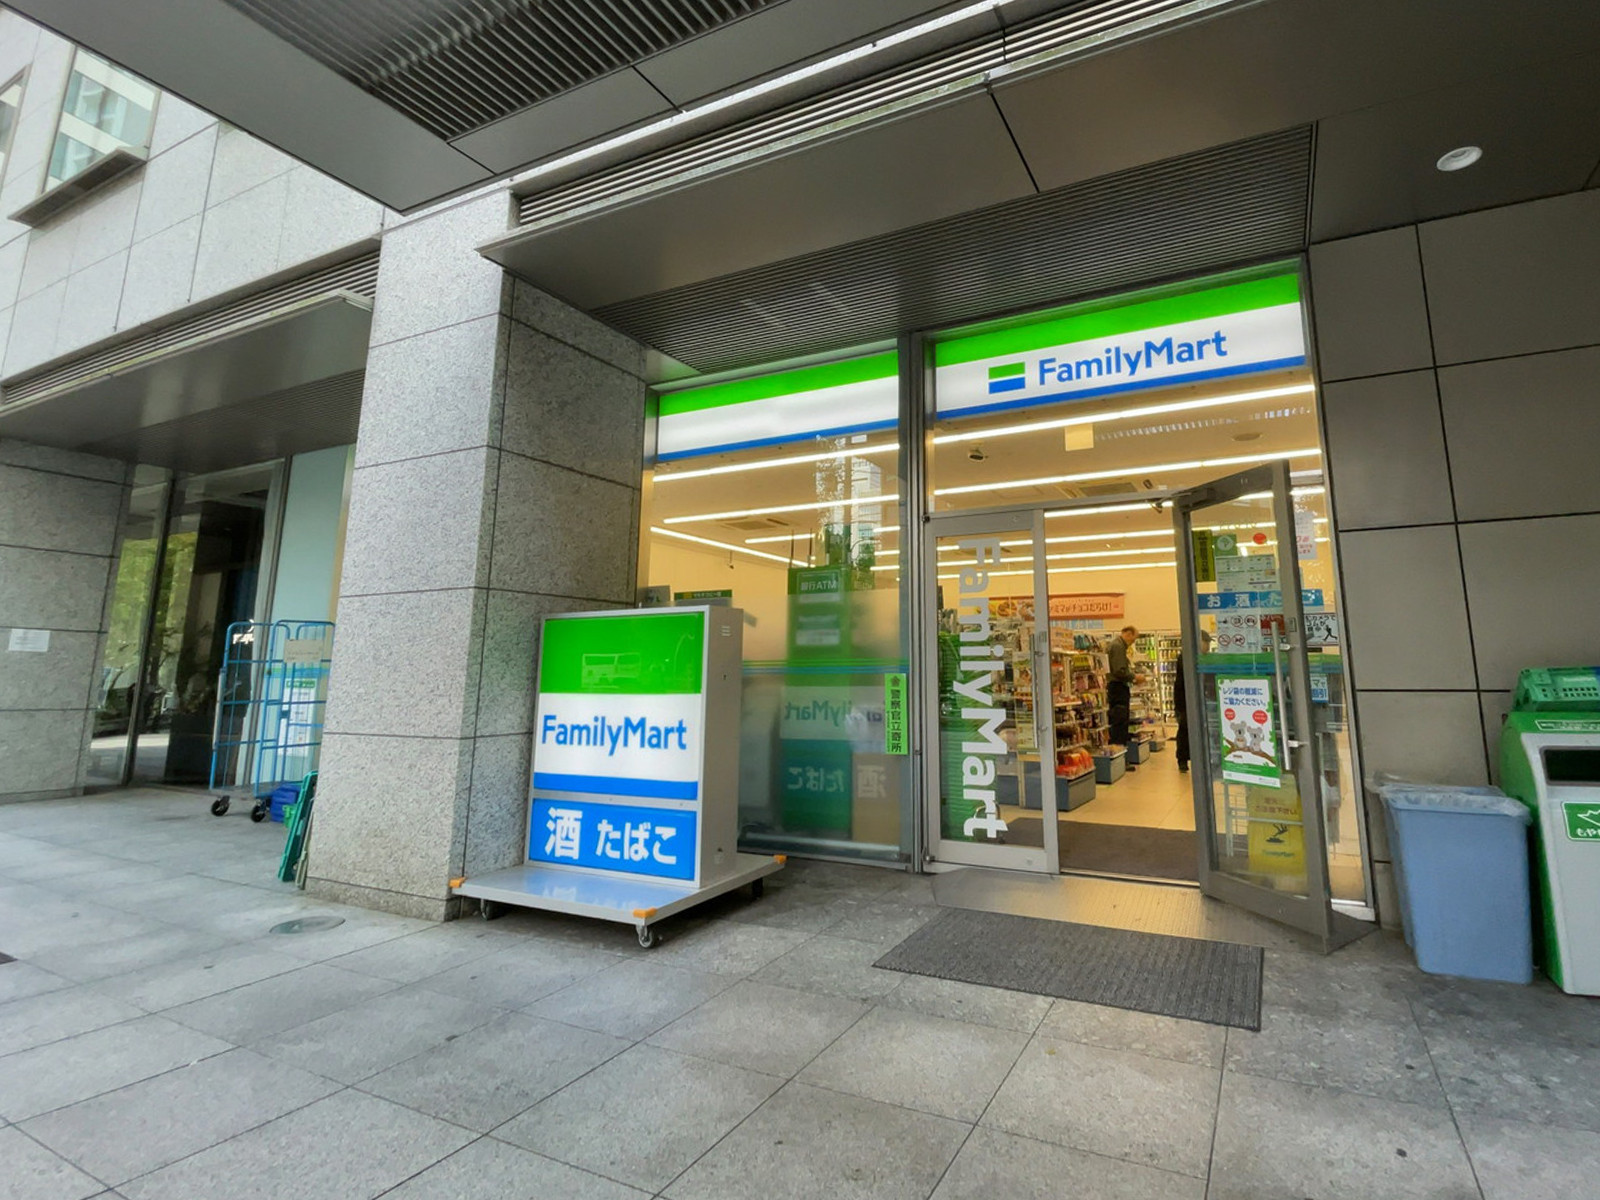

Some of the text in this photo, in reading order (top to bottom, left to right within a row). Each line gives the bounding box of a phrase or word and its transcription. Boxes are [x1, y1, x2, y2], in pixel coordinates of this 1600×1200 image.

[1039, 331, 1227, 385] FamilyMart
[953, 537, 1009, 838] FamilyMart
[541, 714, 687, 756] FamilyMart
[546, 807, 677, 865] 酒 たばこ
